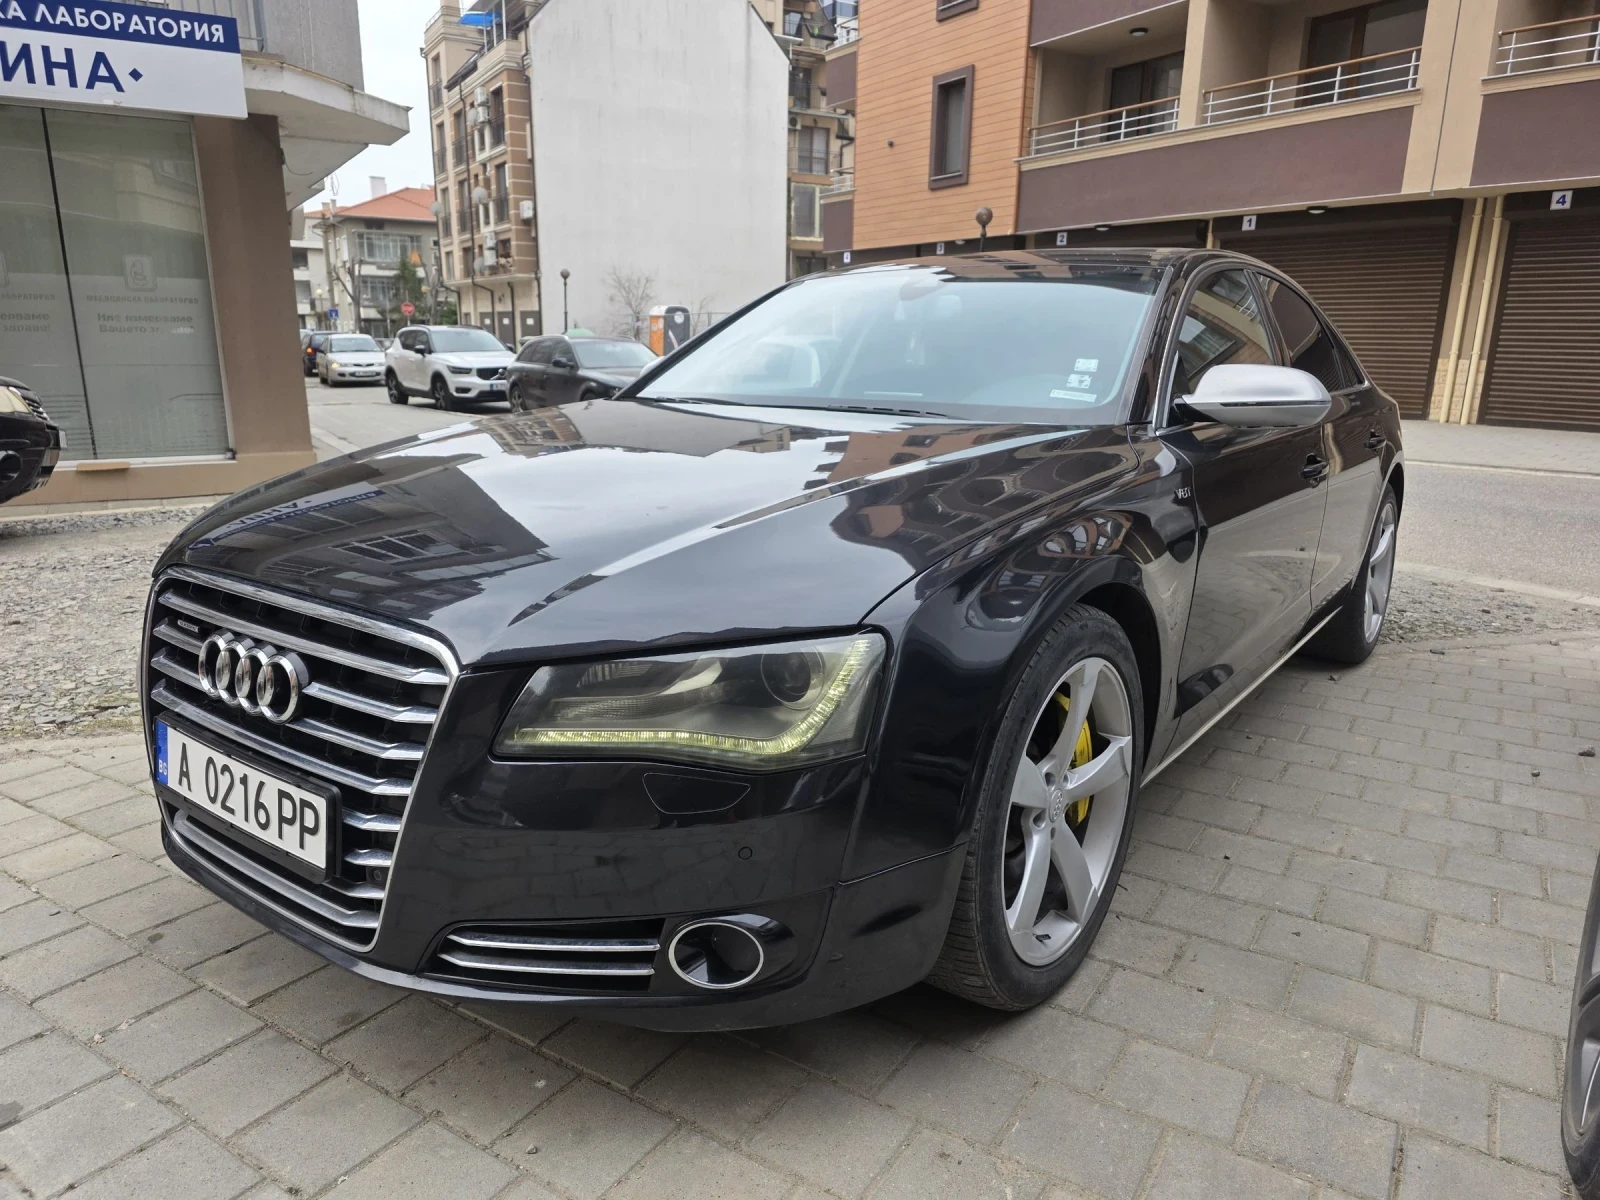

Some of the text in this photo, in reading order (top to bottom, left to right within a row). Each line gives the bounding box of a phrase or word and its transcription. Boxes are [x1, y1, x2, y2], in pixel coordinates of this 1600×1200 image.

[35, 3, 225, 43] ЛАБОРАТОРИЯ
[0, 41, 125, 93] ИНА
[1556, 194, 1567, 206] 4
[1246, 217, 1253, 228] 1
[1059, 234, 1065, 243] 2
[158, 758, 168, 776] BG
[178, 742, 192, 793] A
